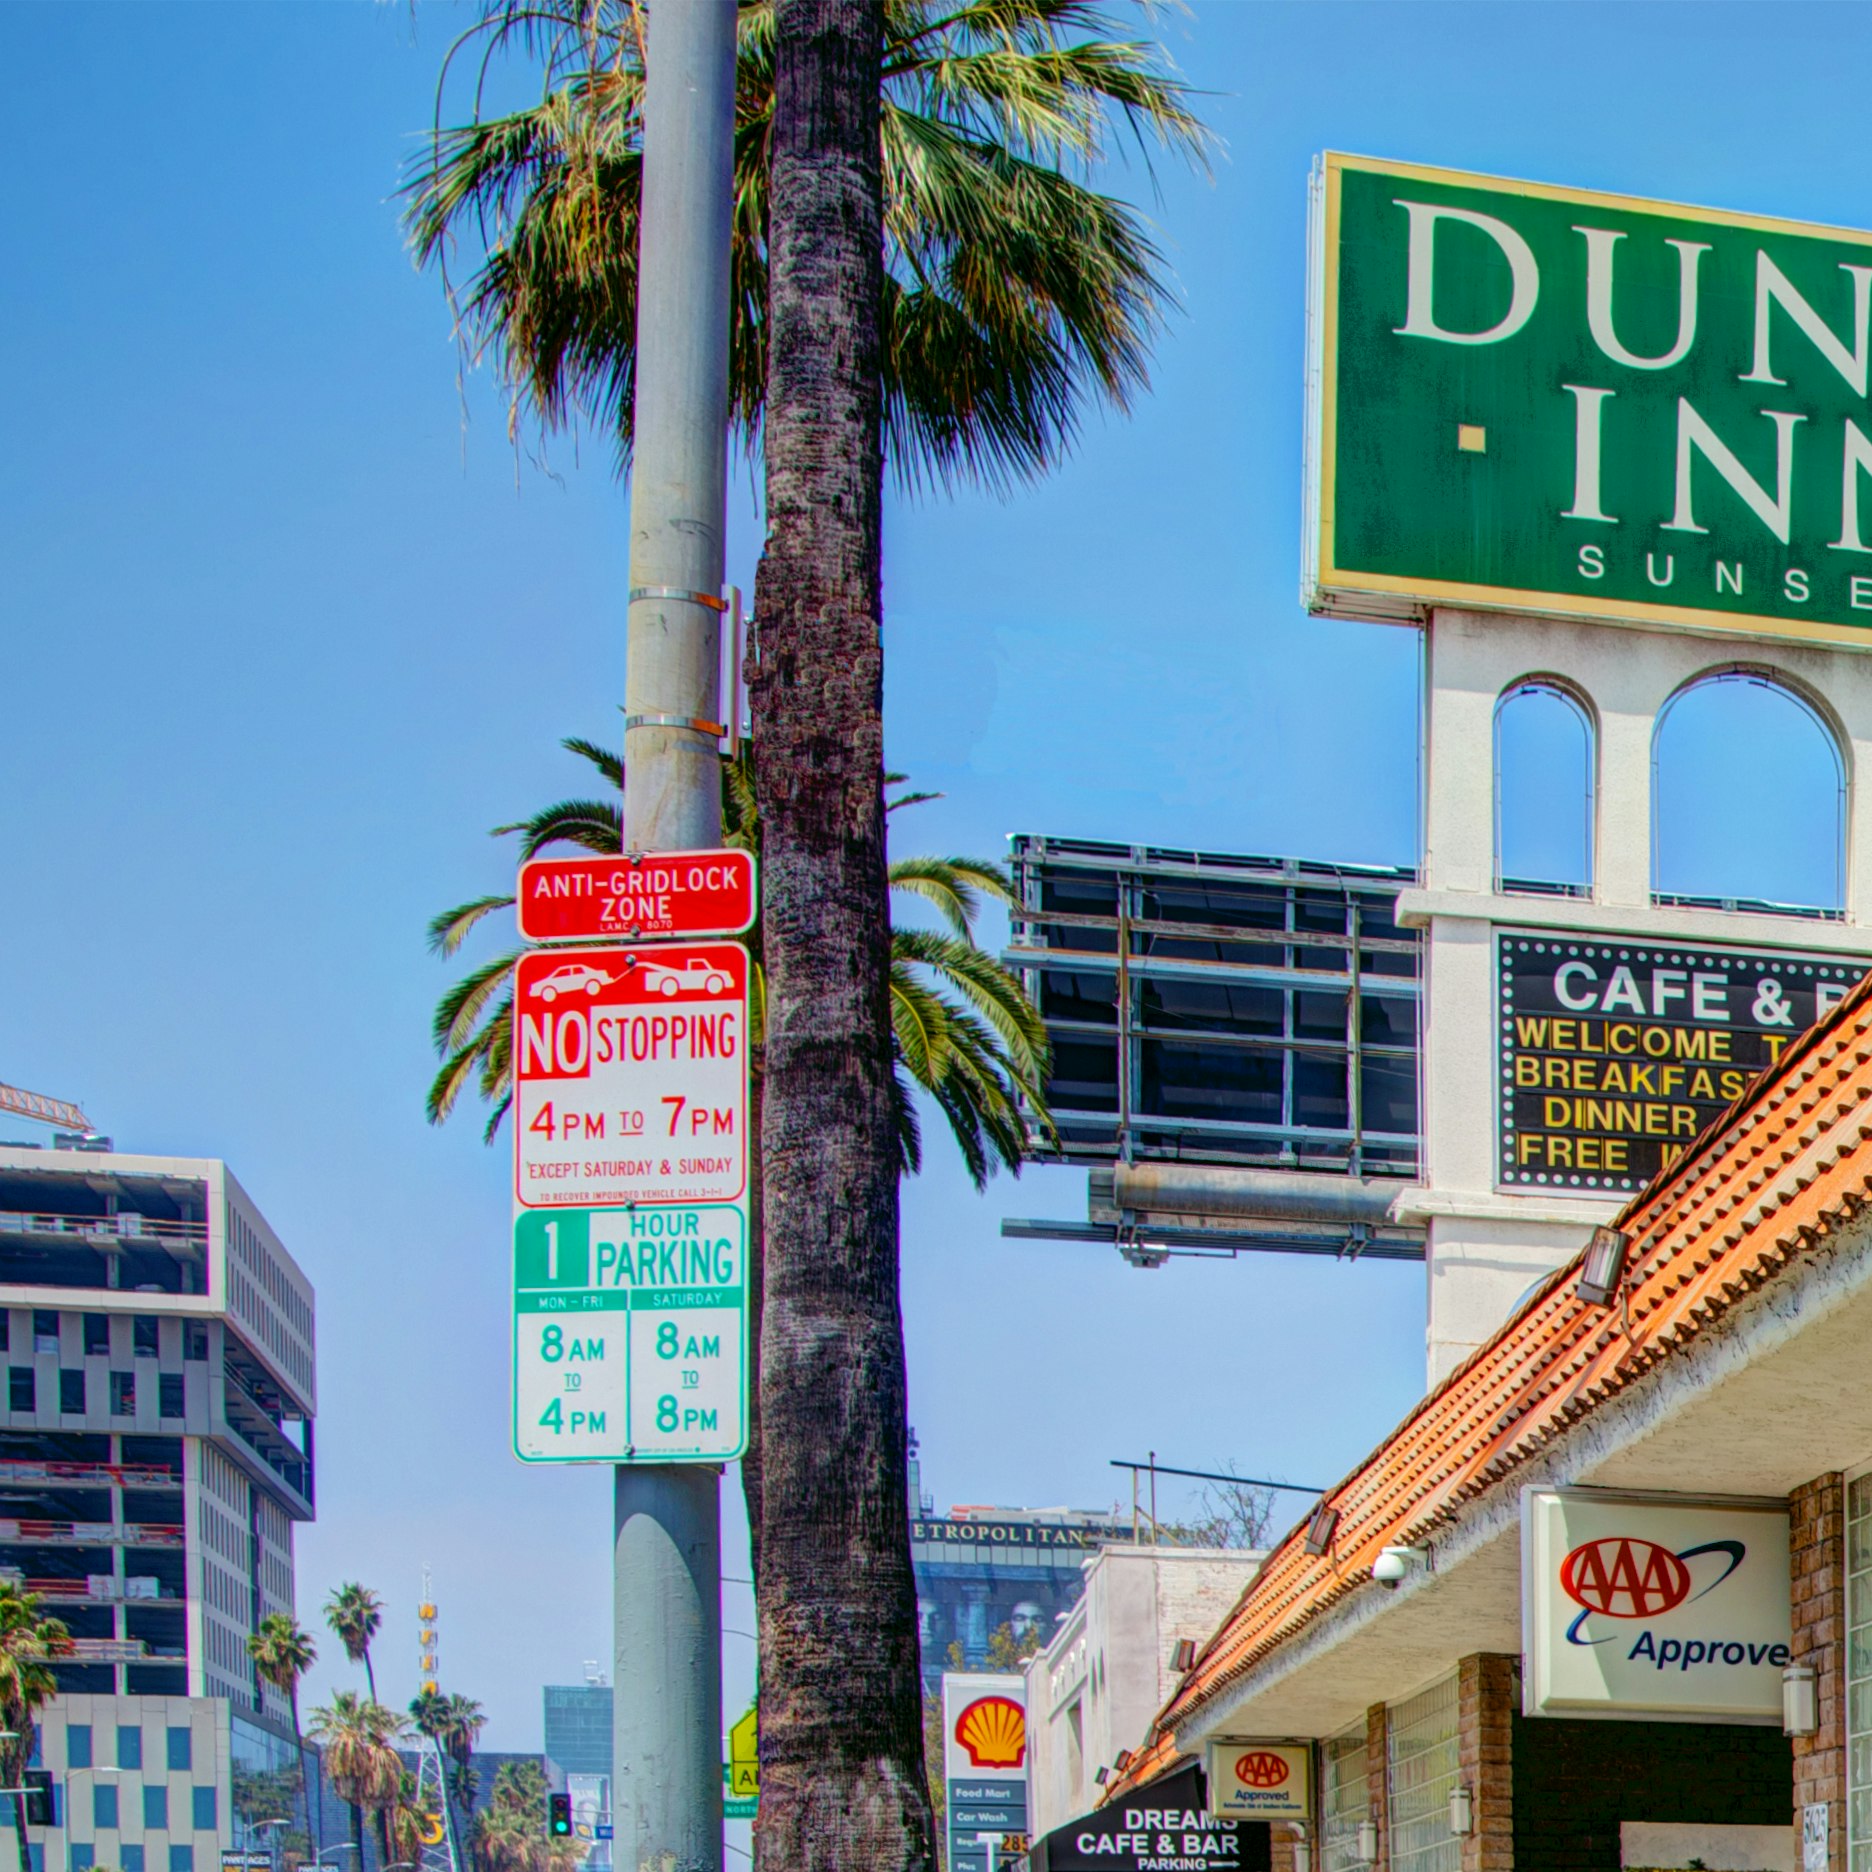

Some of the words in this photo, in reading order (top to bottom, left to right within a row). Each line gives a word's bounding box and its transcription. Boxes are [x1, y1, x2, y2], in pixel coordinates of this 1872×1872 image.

[534, 866, 739, 899] ANTI-GRIDLOCK
[600, 895, 672, 922] ZONE
[1553, 960, 1731, 1021] CAFE
[1752, 978, 1796, 1027] &
[520, 1010, 589, 1075] NO
[597, 1011, 736, 1063] STOPPING
[1515, 1016, 1732, 1063] WELCOME
[1761, 1035, 1788, 1065] T
[1515, 1055, 1758, 1101] BREAKFAS
[619, 1111, 644, 1132] TO
[1544, 1095, 1697, 1137] DINNER
[1519, 1132, 1629, 1172] FREE
[529, 1162, 580, 1180] EXCEPT
[584, 1160, 653, 1178] SATURDAY
[659, 1158, 672, 1176] &
[679, 1157, 733, 1175] SUNDAY
[540, 1192, 551, 1202] TO
[553, 1191, 590, 1201] RECOVER
[593, 1189, 640, 1200] IMPOUNDED
[642, 1188, 676, 1199] VEHICLE
[678, 1188, 698, 1198] CALL
[630, 1212, 700, 1237] HOUR
[544, 1220, 559, 1280] 1
[597, 1238, 733, 1287] PARKING
[538, 1297, 567, 1309] MON
[582, 1295, 604, 1308] FRI
[653, 1292, 723, 1307] SATURDAY
[564, 1373, 582, 1389] TO
[682, 1371, 699, 1386] TO
[912, 1522, 1084, 1544] ETROPOLITAN
[1570, 1538, 1682, 1617] AAA
[1628, 1630, 1794, 1671] Approve
[1238, 1752, 1287, 1787] AAA
[955, 1788, 982, 1798] Food
[985, 1788, 1011, 1799] Mart
[1235, 1789, 1290, 1802] Approved
[956, 1812, 976, 1822] Car
[978, 1812, 1008, 1823] Wash
[1077, 1834, 1151, 1855] CAFE
[1157, 1834, 1177, 1855] &
[1183, 1834, 1240, 1855] BAR
[1137, 1857, 1206, 1871] PARKING
